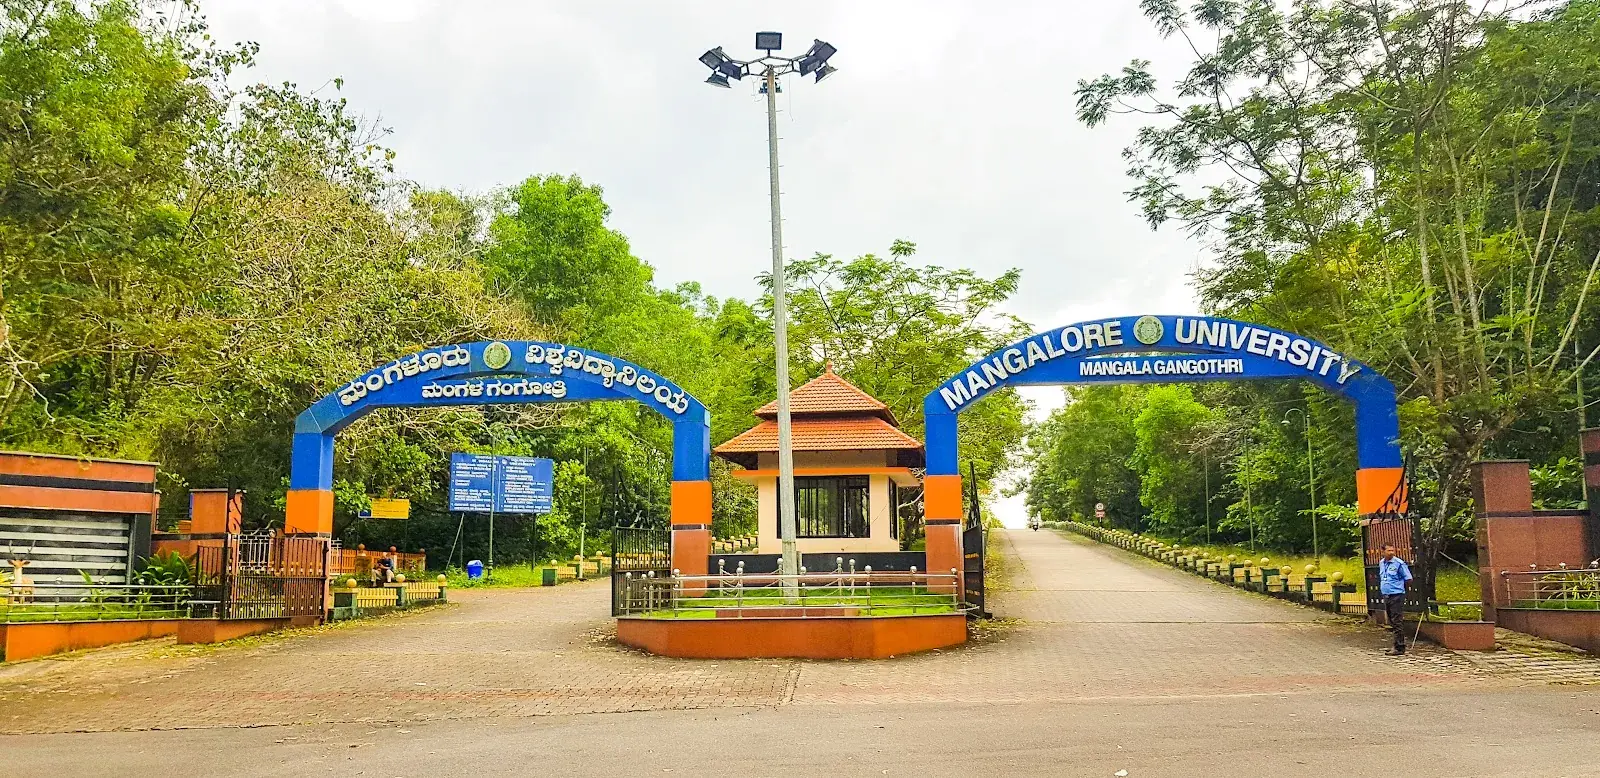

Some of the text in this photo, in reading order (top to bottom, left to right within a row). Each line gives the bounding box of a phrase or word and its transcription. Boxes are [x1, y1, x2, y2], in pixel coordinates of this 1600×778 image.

[338, 344, 689, 414] ಮಂಗಳೂರು ವಿಶ್ವವಿದ್ಯಾನಿಲಯ
[939, 318, 1362, 411] MANGALORE UNIVERSITY
[1079, 359, 1244, 376] MANGALA GANGOTHRI
[421, 378, 567, 398] ಮಂಗಳ ಗಂಗೋತ್ರಿ
